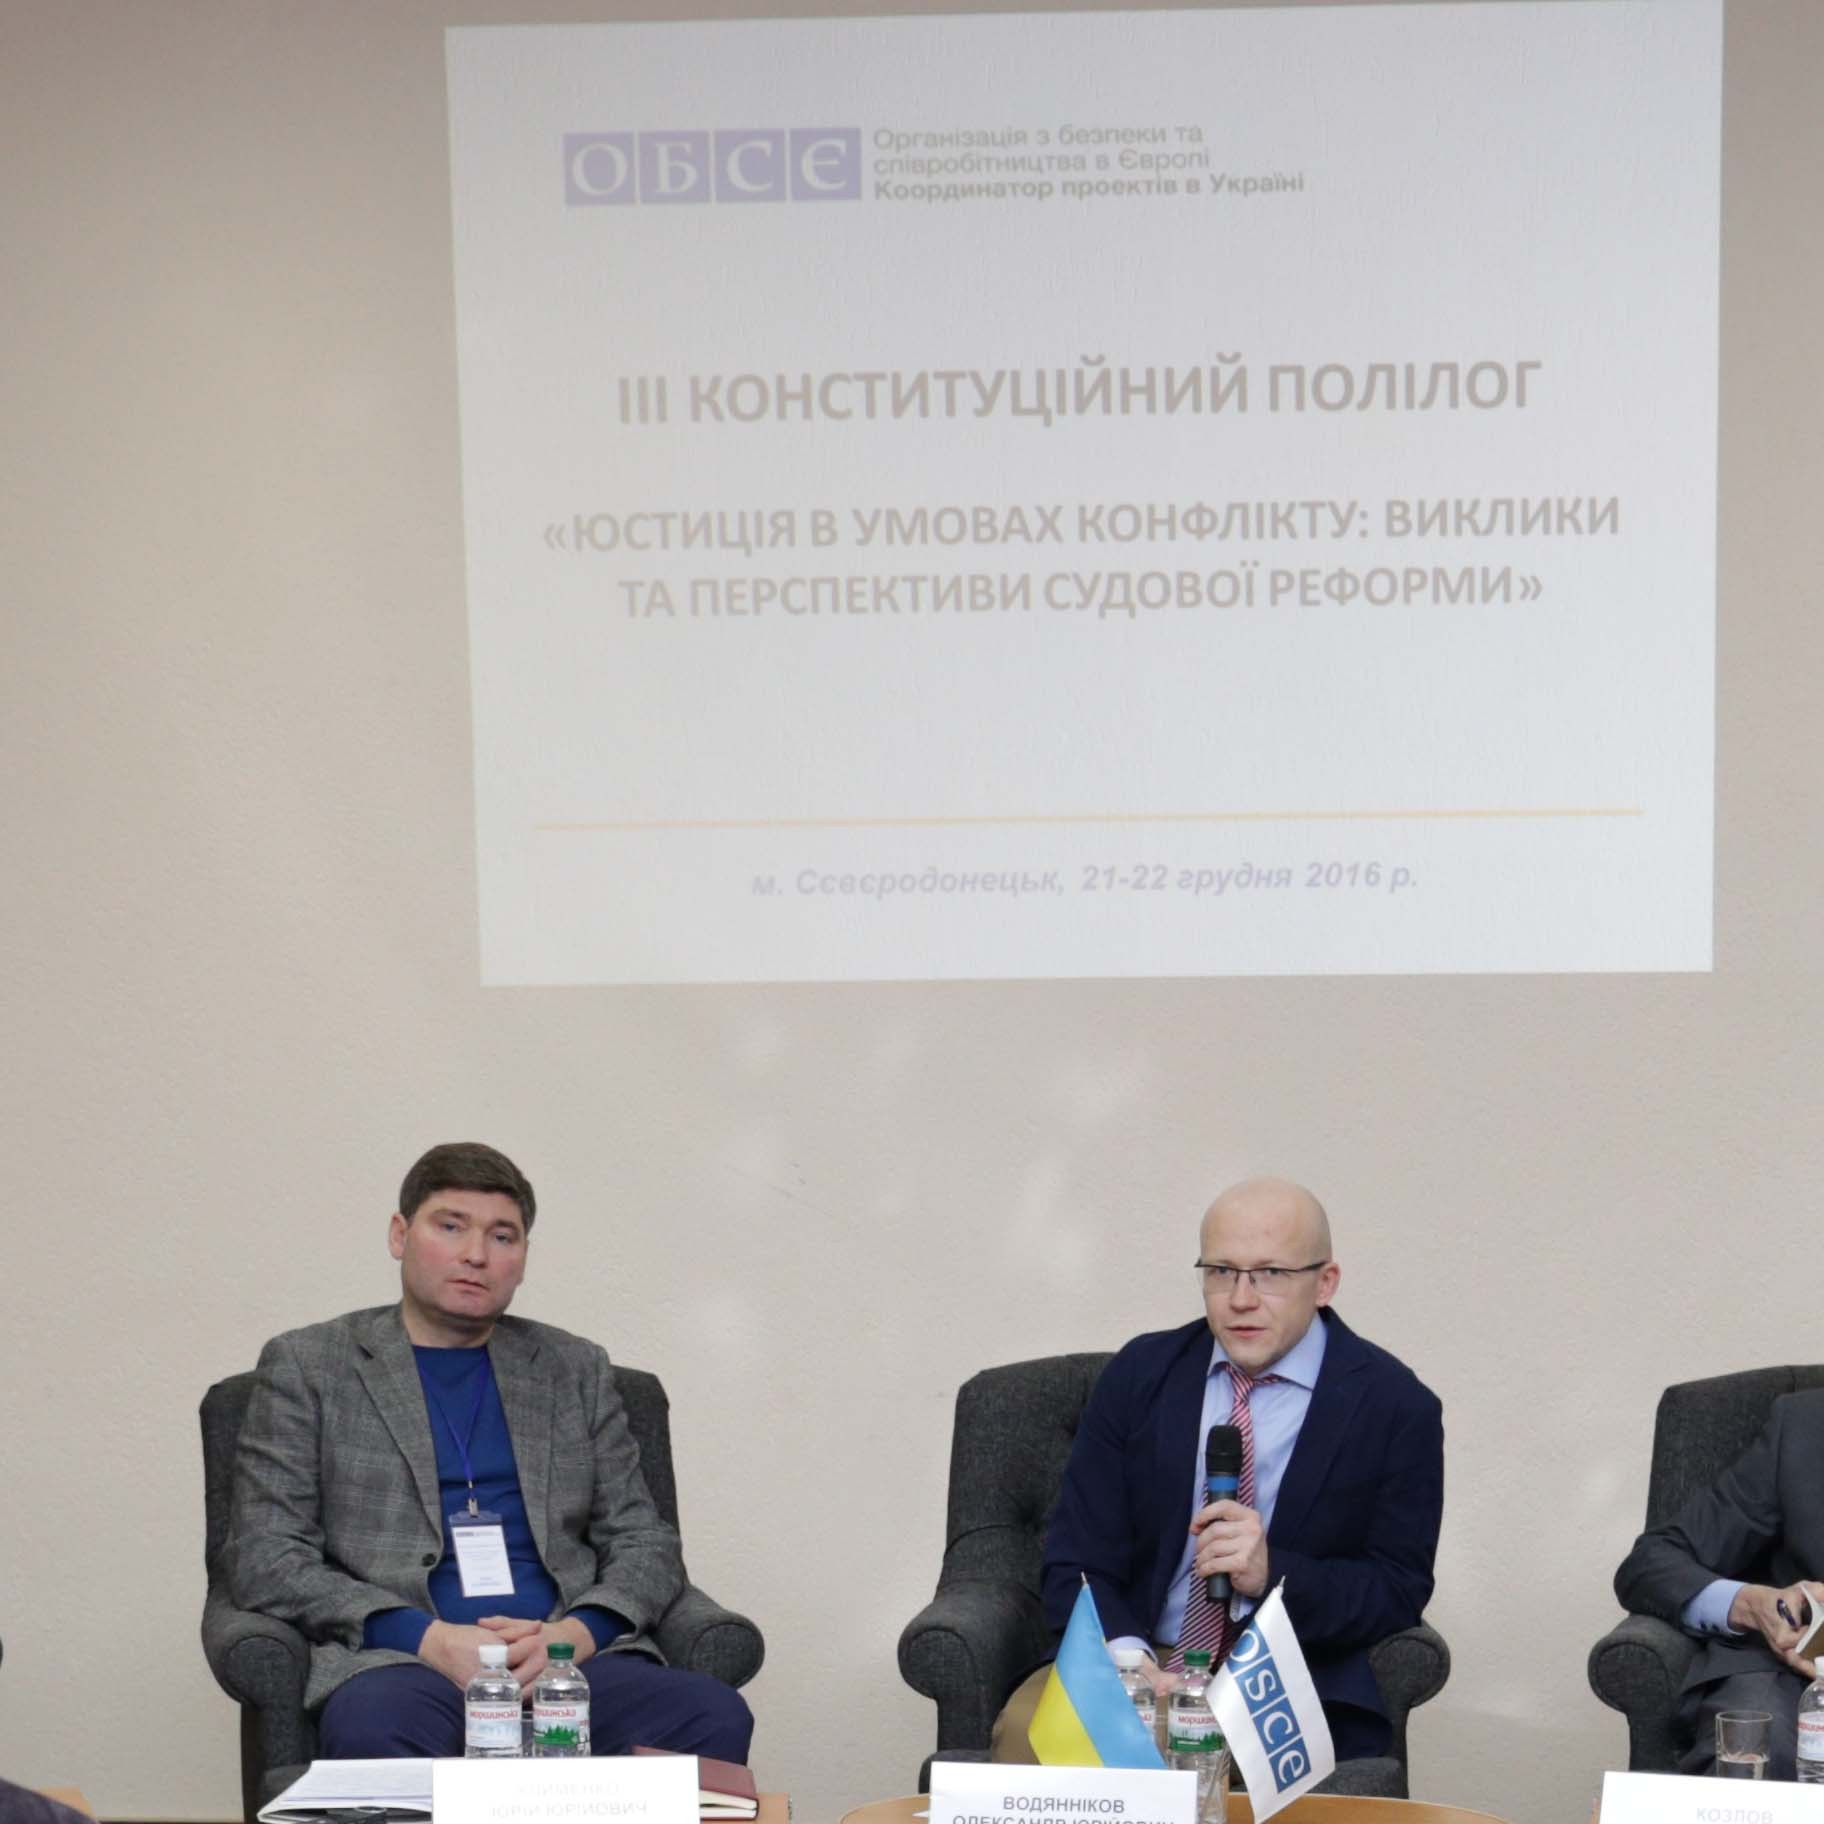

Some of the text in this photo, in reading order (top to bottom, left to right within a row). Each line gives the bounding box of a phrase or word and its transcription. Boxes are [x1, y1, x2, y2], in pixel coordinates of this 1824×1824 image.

[873, 124, 1204, 152] Організація з безпеки та
[570, 136, 852, 197] ОБСЄ
[873, 147, 1210, 176] співробітництва в Європі
[874, 172, 1305, 203] Координатор проектів в Україні
[688, 351, 1249, 427] КОНСТИТУЦІЙНИЙ
[1267, 359, 1543, 413] ПОЛІЛОГ
[542, 496, 1620, 557] «ЮСТИЦІЯ В УМОВАХ КОНФЛІКТУ: ВИКЛИКИ
[617, 560, 1544, 619] ТА ПЕРСПЕКТИВИ СУДОВОЇ РЕФОРМИ»
[750, 874, 784, 896] м.
[1081, 863, 1169, 892] 21-22
[1176, 861, 1293, 896] грудня
[1304, 860, 1382, 889] 2016
[1388, 864, 1418, 895] р.
[1002, 1796, 1126, 1814] ВОДЯННІКОВ
[1695, 1807, 1774, 1824] КОЗЛОВ
